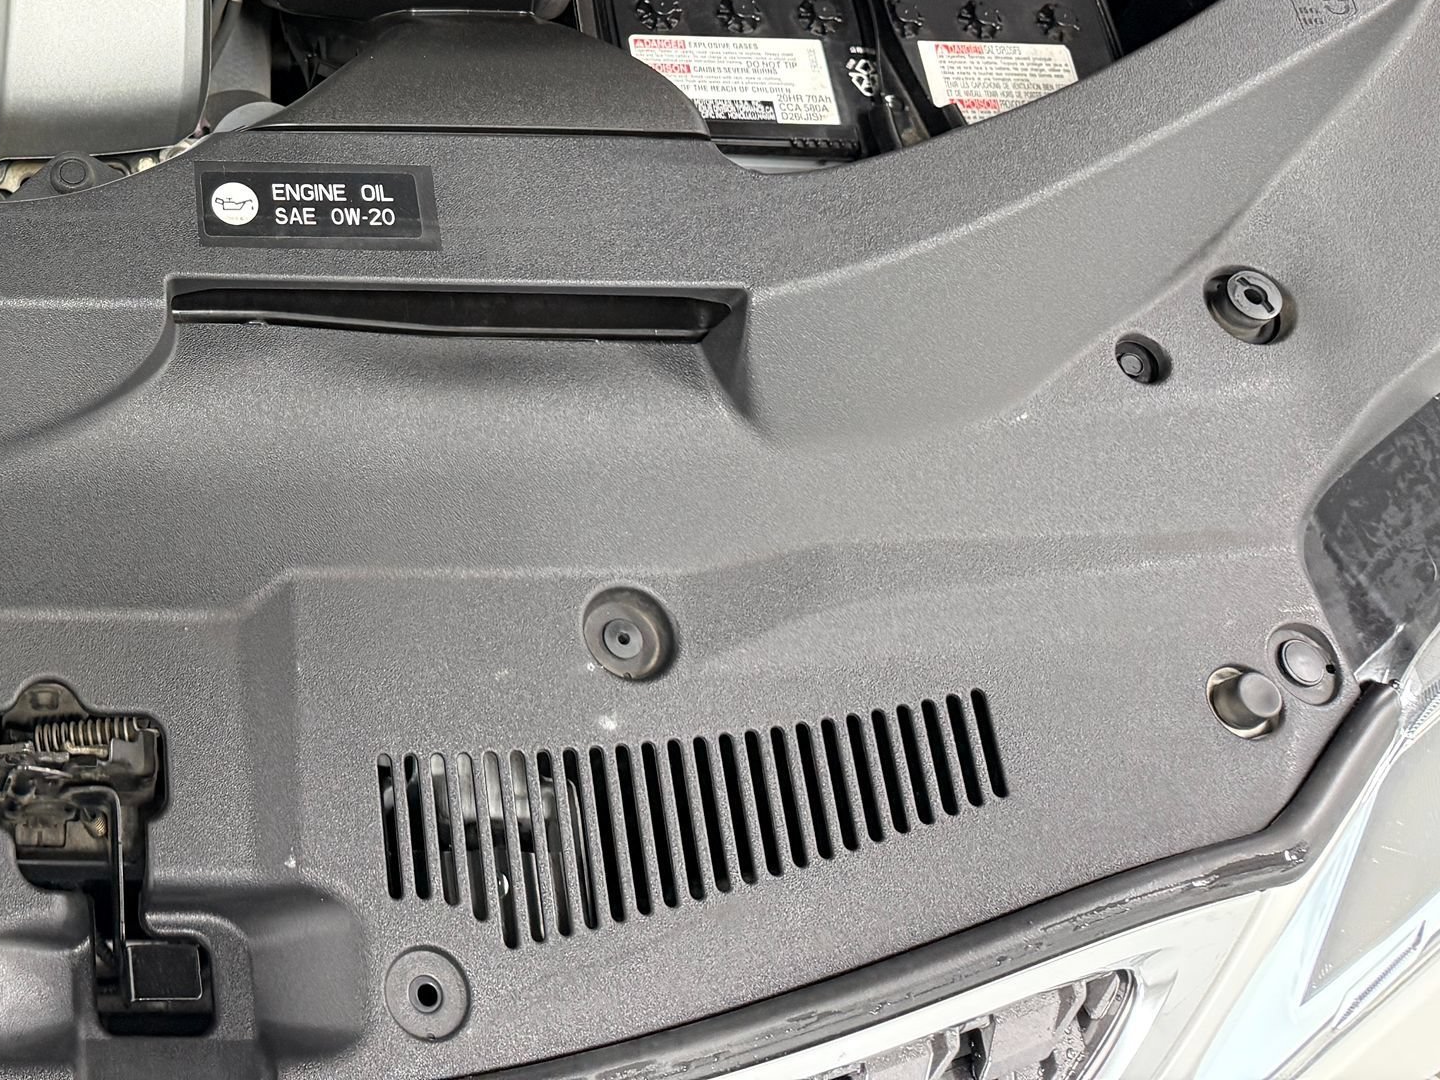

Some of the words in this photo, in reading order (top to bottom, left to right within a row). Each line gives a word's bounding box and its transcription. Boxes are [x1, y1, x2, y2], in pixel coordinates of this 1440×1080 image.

[644, 39, 685, 49] DANGER
[746, 60, 760, 69] DO
[762, 61, 781, 70] NOT
[784, 61, 798, 70] TIP
[693, 84, 709, 92] THE
[710, 85, 737, 93] REACH
[739, 85, 750, 93] OF
[779, 102, 802, 112] CCA
[271, 183, 348, 202] ENGINE
[360, 184, 395, 202] OIL
[275, 207, 317, 225] SAE
[331, 207, 396, 226] 0W-20
